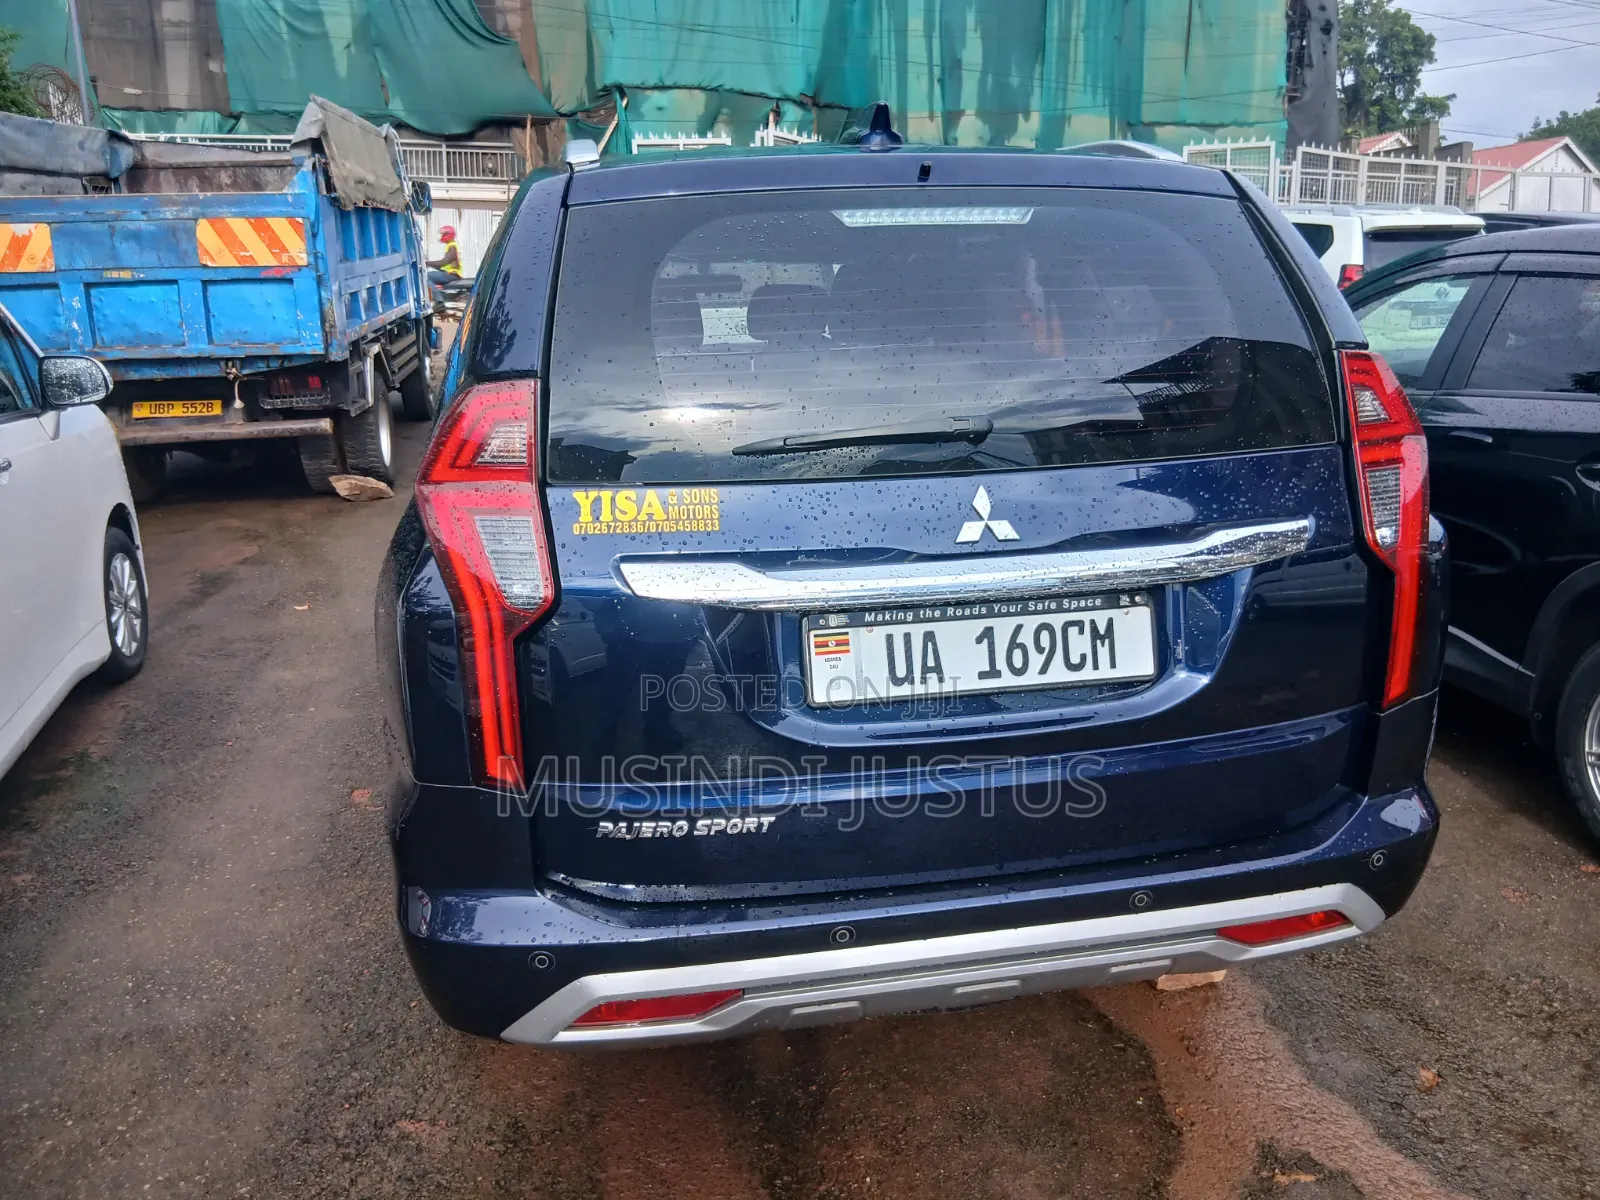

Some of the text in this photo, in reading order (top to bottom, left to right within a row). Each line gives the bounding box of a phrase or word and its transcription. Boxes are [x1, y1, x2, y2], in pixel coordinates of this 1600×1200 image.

[149, 401, 215, 415] UBP 552B
[572, 489, 667, 523] YISA
[668, 488, 718, 504] & SONS
[668, 504, 720, 520] MOTORS
[572, 519, 720, 535] 0702672836/0705458833
[864, 611, 914, 623] Making
[919, 608, 942, 619] the
[946, 605, 988, 617] Roads
[993, 603, 1023, 614] Your
[1028, 600, 1057, 612] Safe
[1062, 597, 1102, 610] Space
[885, 616, 1117, 687] UA 169CM
[595, 816, 777, 840] PAJERO SPORT
